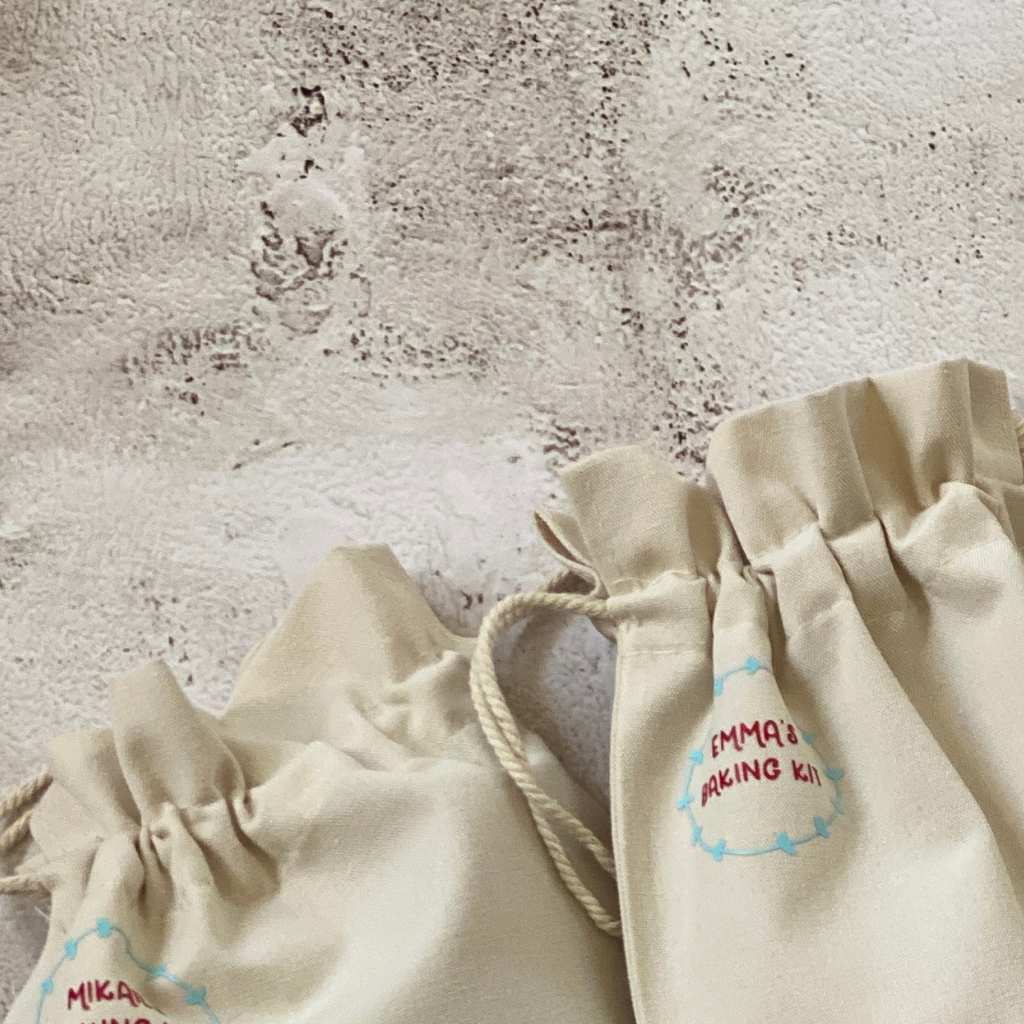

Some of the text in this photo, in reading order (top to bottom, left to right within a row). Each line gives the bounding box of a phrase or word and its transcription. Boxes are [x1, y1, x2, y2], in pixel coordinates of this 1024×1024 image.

[711, 719, 798, 759] EMMA'S
[701, 757, 781, 807] BAKING
[67, 979, 143, 1011] MIKA
